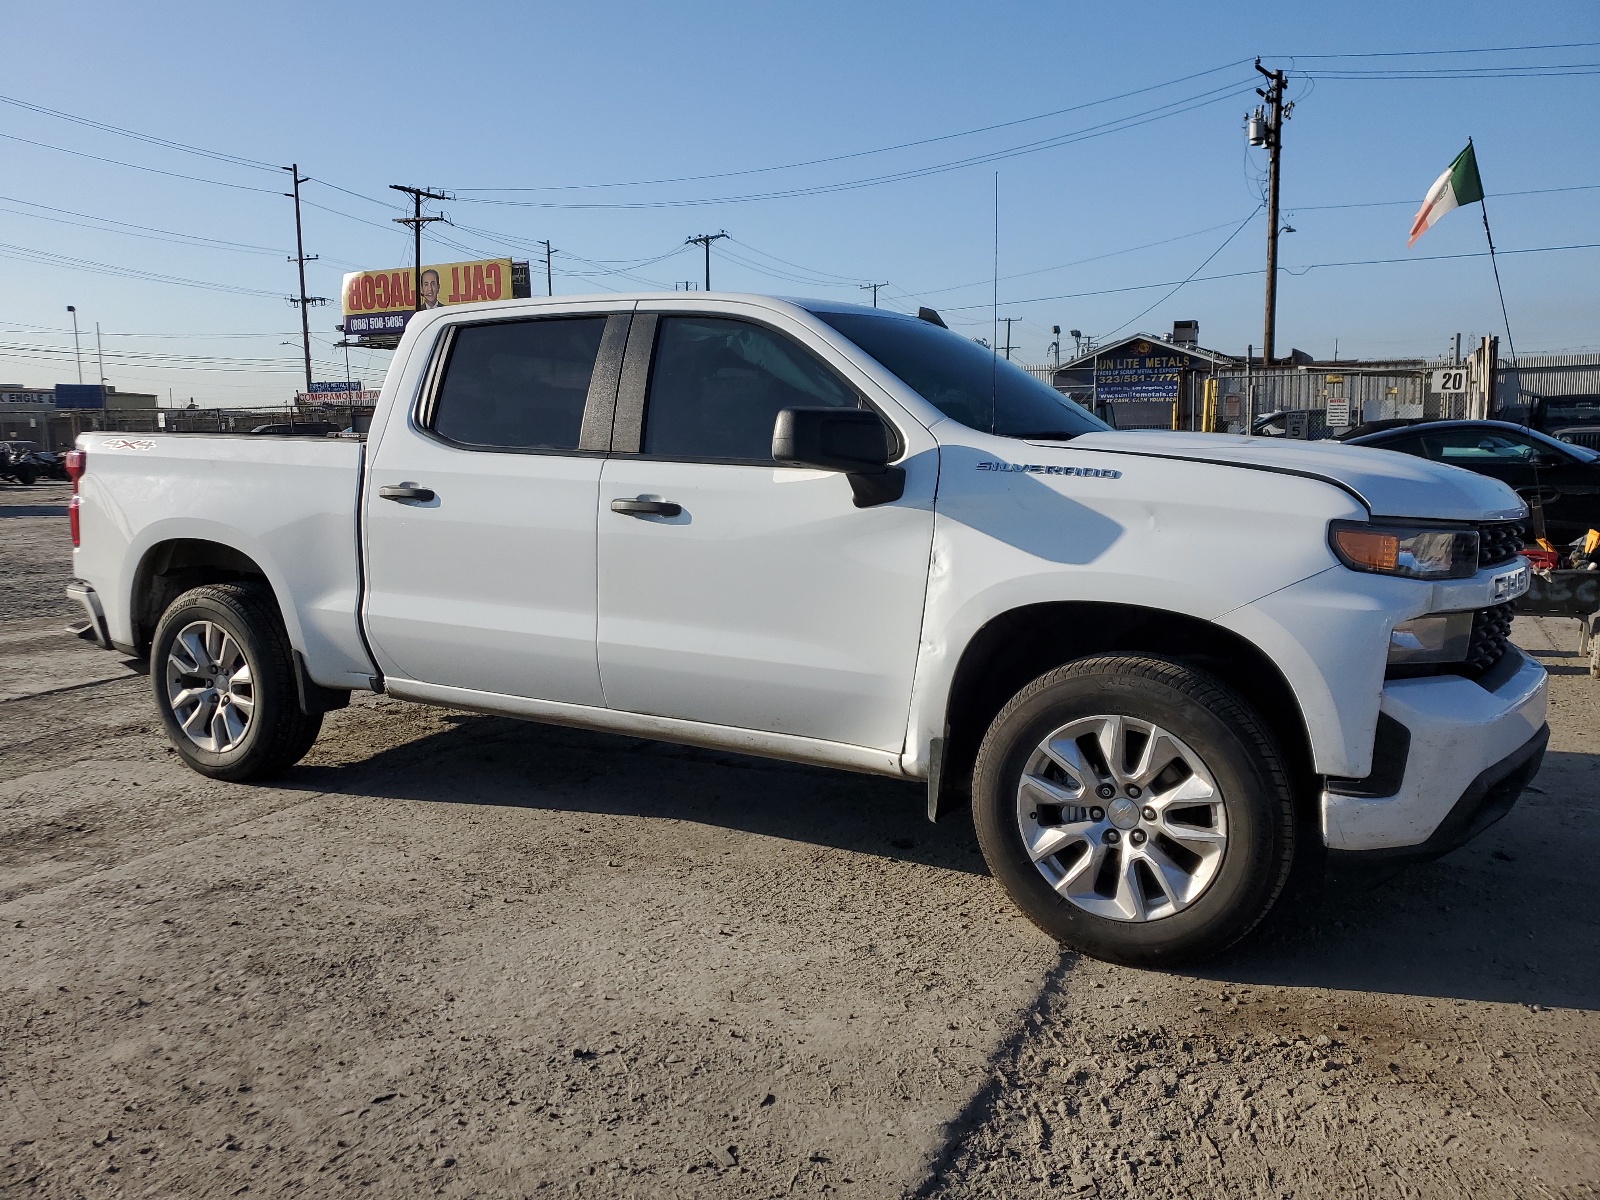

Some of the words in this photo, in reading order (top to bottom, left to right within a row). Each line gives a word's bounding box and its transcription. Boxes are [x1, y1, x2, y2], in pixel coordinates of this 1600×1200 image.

[1117, 359, 1139, 369] LITE
[1145, 356, 1189, 368] METALS
[1441, 372, 1464, 390] 20
[9, 394, 44, 403] ENGLE
[299, 393, 354, 402] COMPRAMOS
[1291, 426, 1301, 437] 5
[975, 462, 1123, 479] SILVERADO
